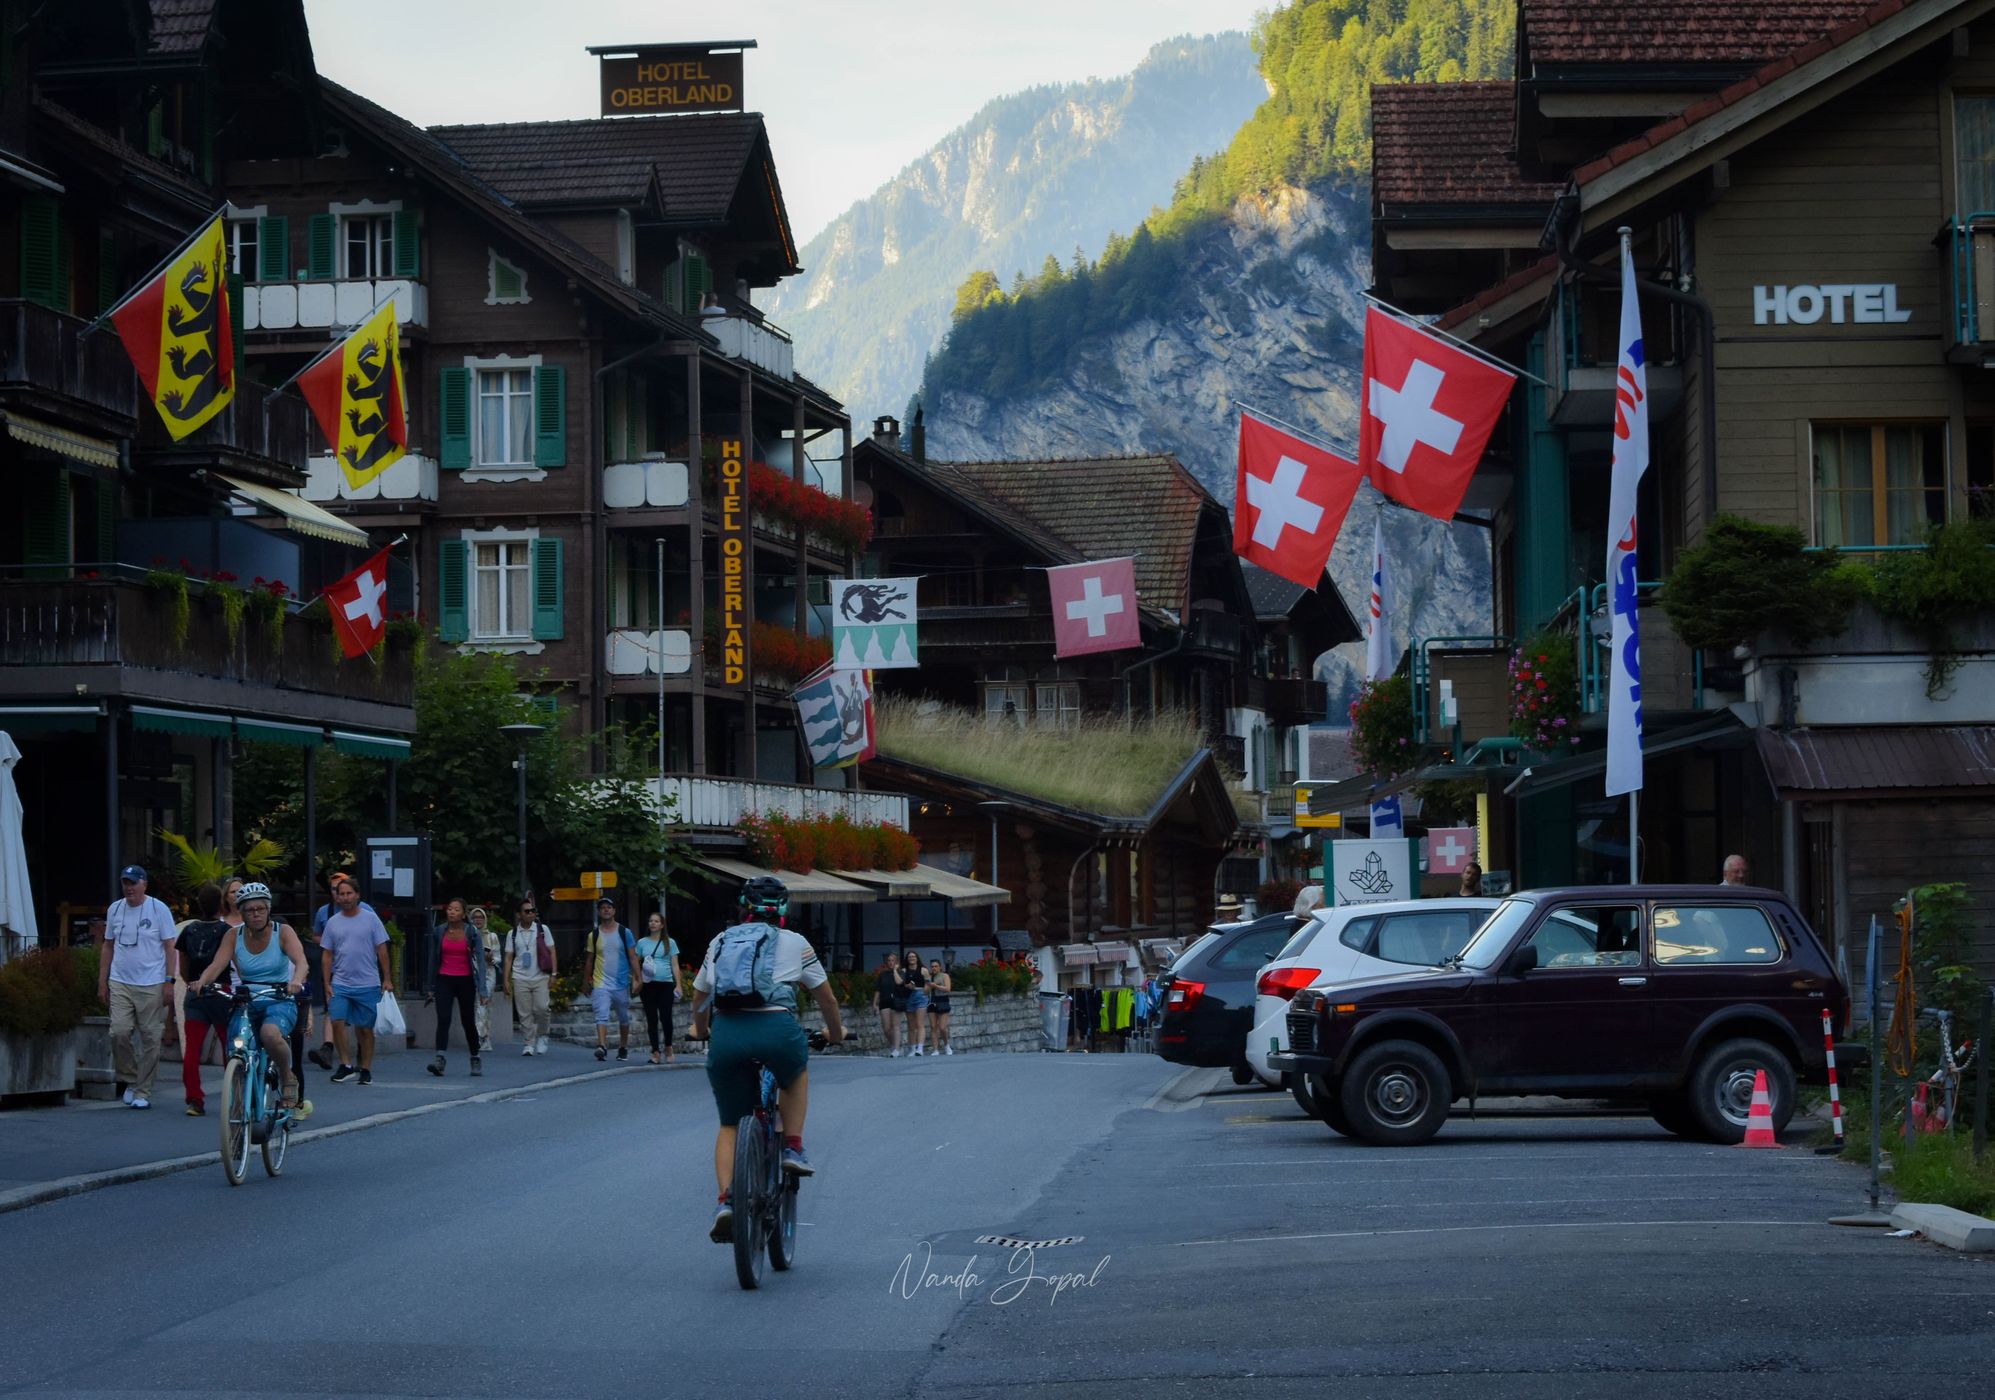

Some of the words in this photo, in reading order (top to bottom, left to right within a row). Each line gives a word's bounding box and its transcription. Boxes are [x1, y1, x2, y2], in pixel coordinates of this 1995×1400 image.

[637, 62, 711, 83] HOTEL
[610, 84, 733, 108] OBERLAND
[1753, 284, 1913, 326] HOTEL
[722, 440, 742, 531] HOTEL
[723, 538, 744, 684] OBERLAND
